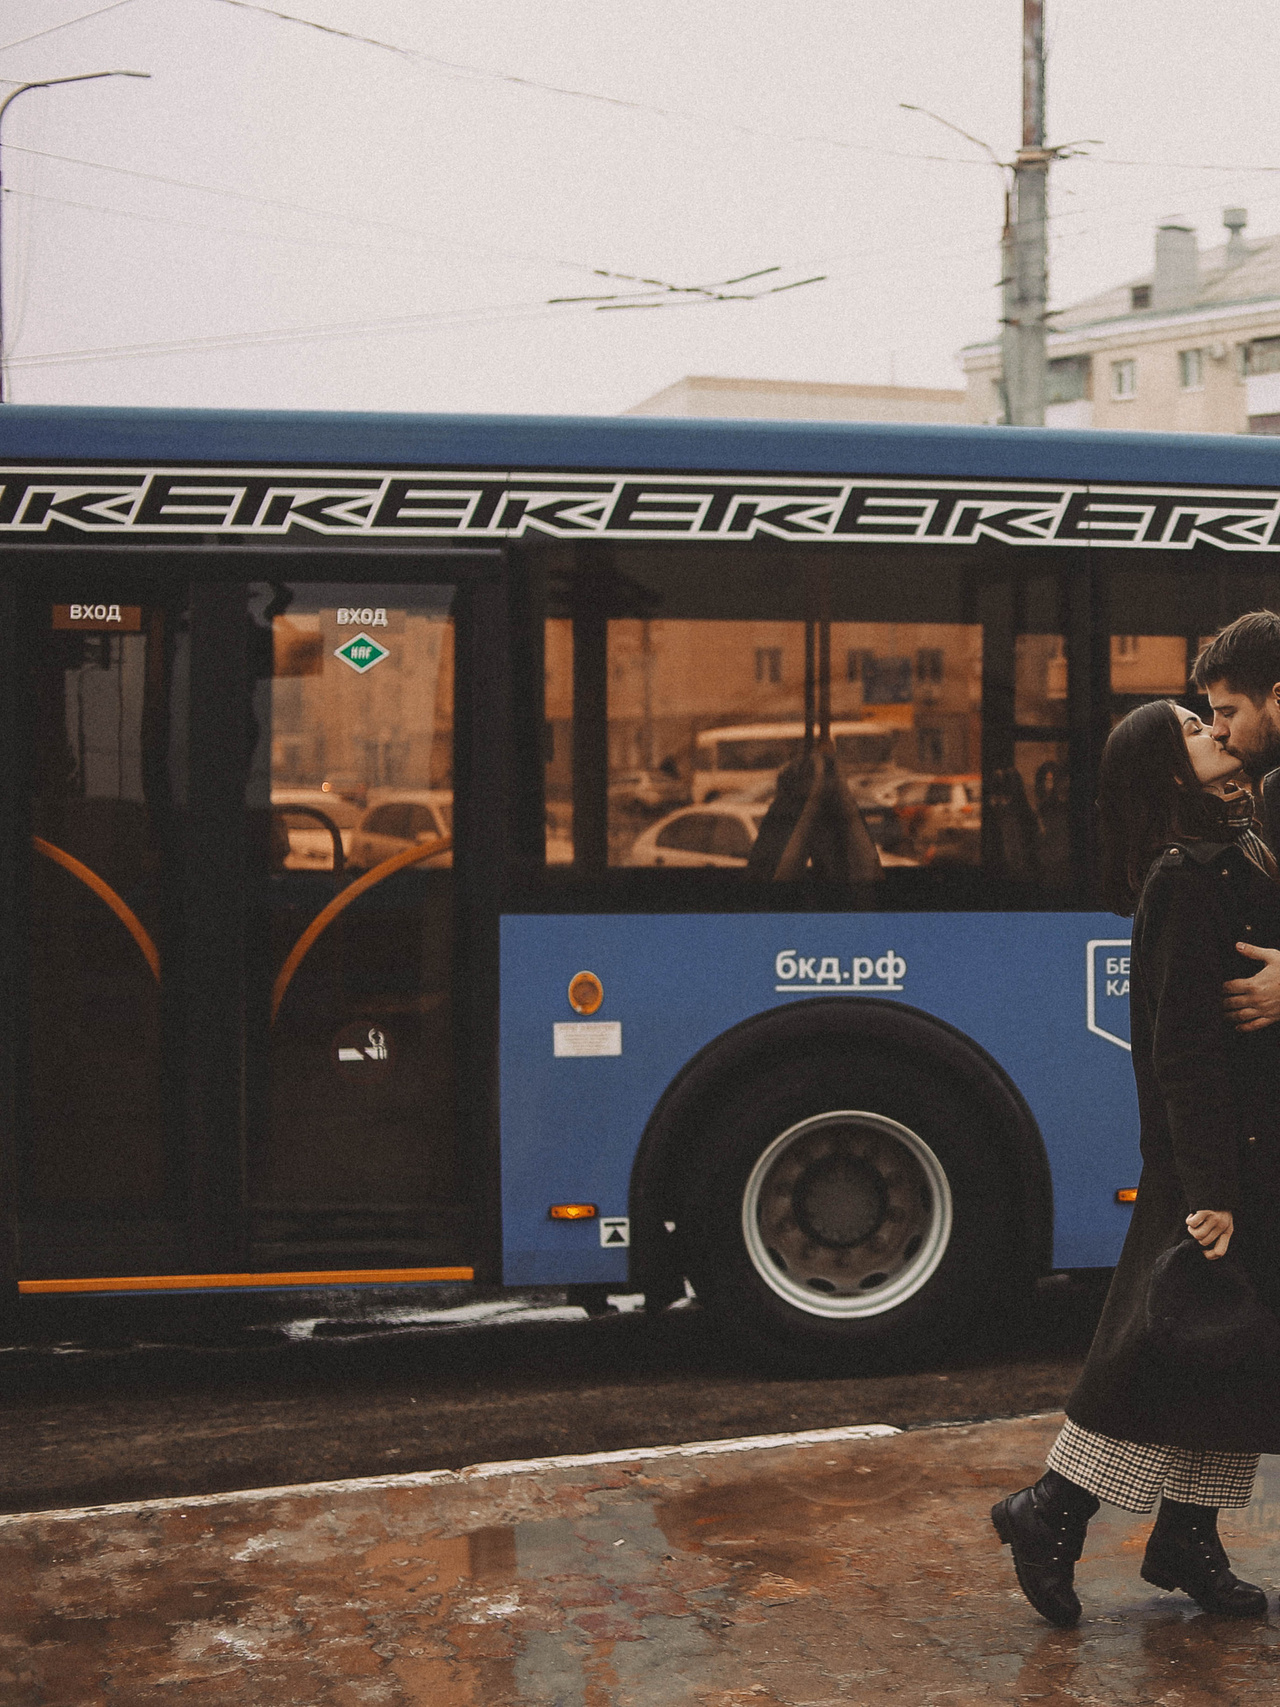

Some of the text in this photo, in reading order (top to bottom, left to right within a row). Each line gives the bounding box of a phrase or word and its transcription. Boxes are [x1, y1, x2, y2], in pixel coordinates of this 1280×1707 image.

[0, 474, 147, 524] ТК
[70, 604, 121, 622] ВХОД
[337, 608, 388, 627] ВХОД
[776, 949, 906, 986] бкд.рф
[1106, 957, 1130, 975] БЕ
[1106, 979, 1130, 996] КА
